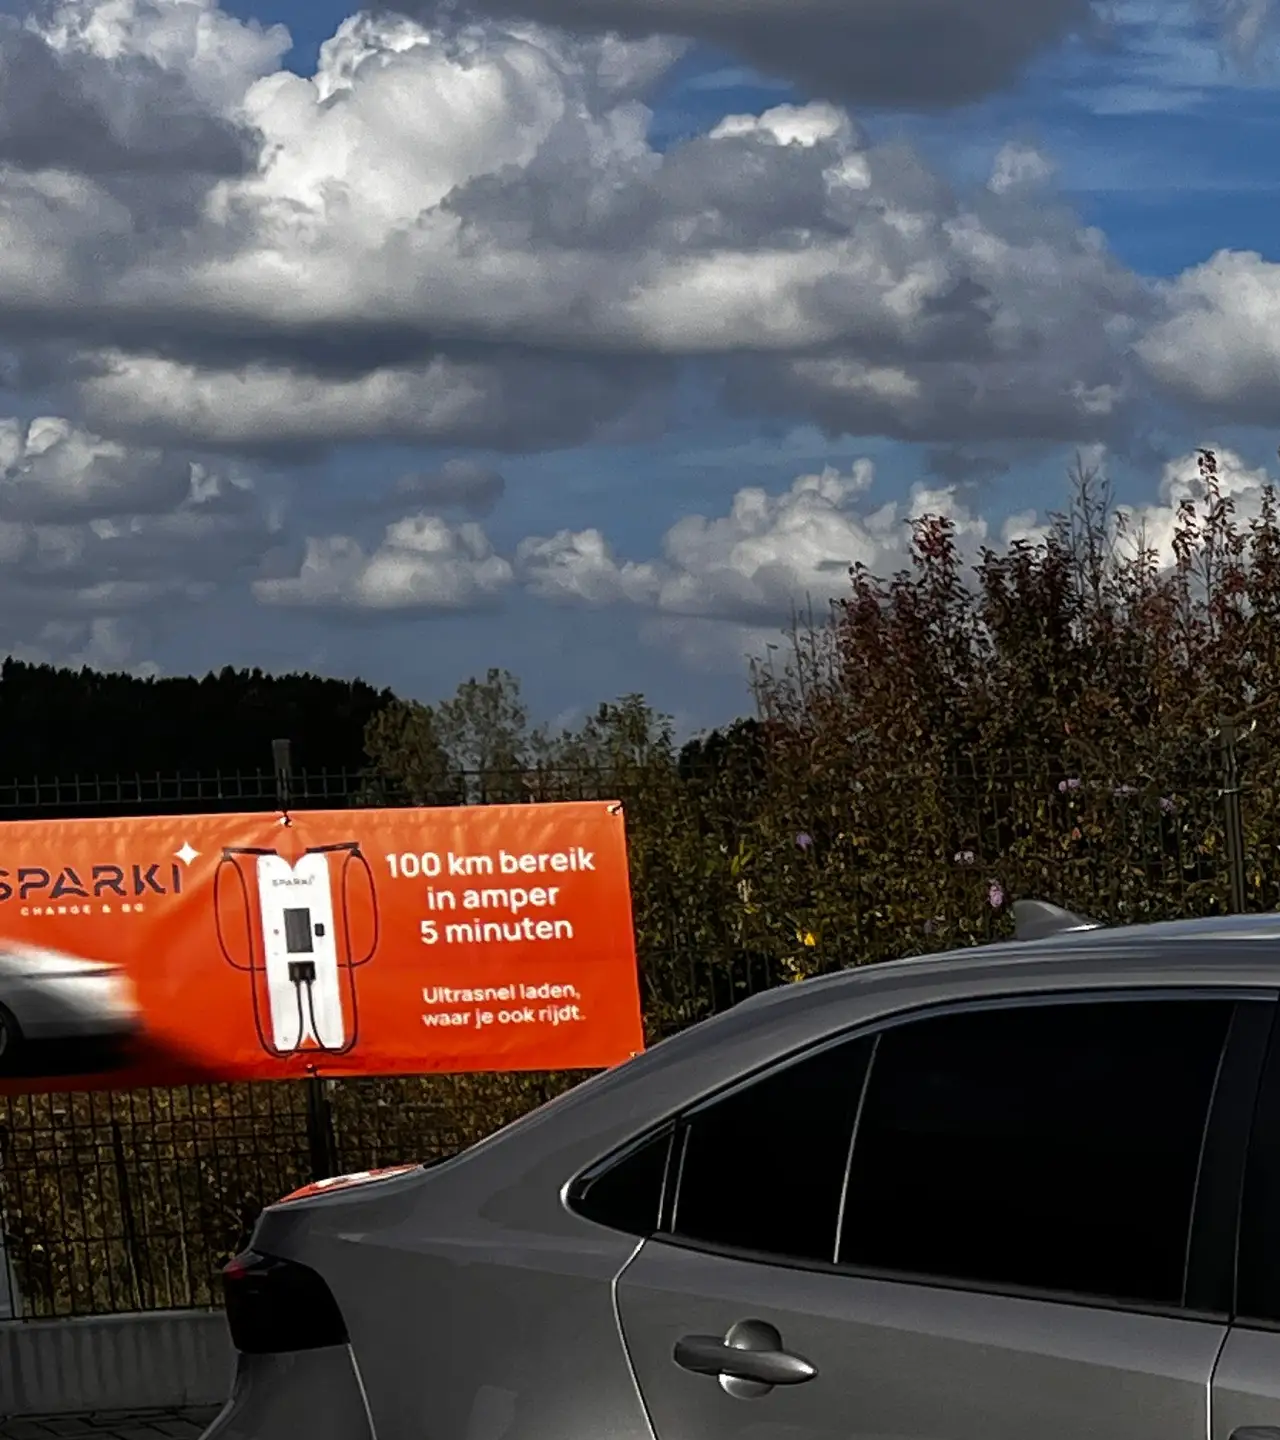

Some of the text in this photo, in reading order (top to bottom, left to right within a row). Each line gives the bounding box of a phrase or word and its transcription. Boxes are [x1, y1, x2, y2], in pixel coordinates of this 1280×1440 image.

[385, 847, 596, 878] 100 km bereik
[0, 863, 181, 901] SPARKI
[427, 886, 560, 914] in amper
[420, 917, 574, 944] 5 minuten
[422, 982, 581, 1004] Ultrasnel laden,
[422, 1004, 587, 1029] waar je ook rijdt.
